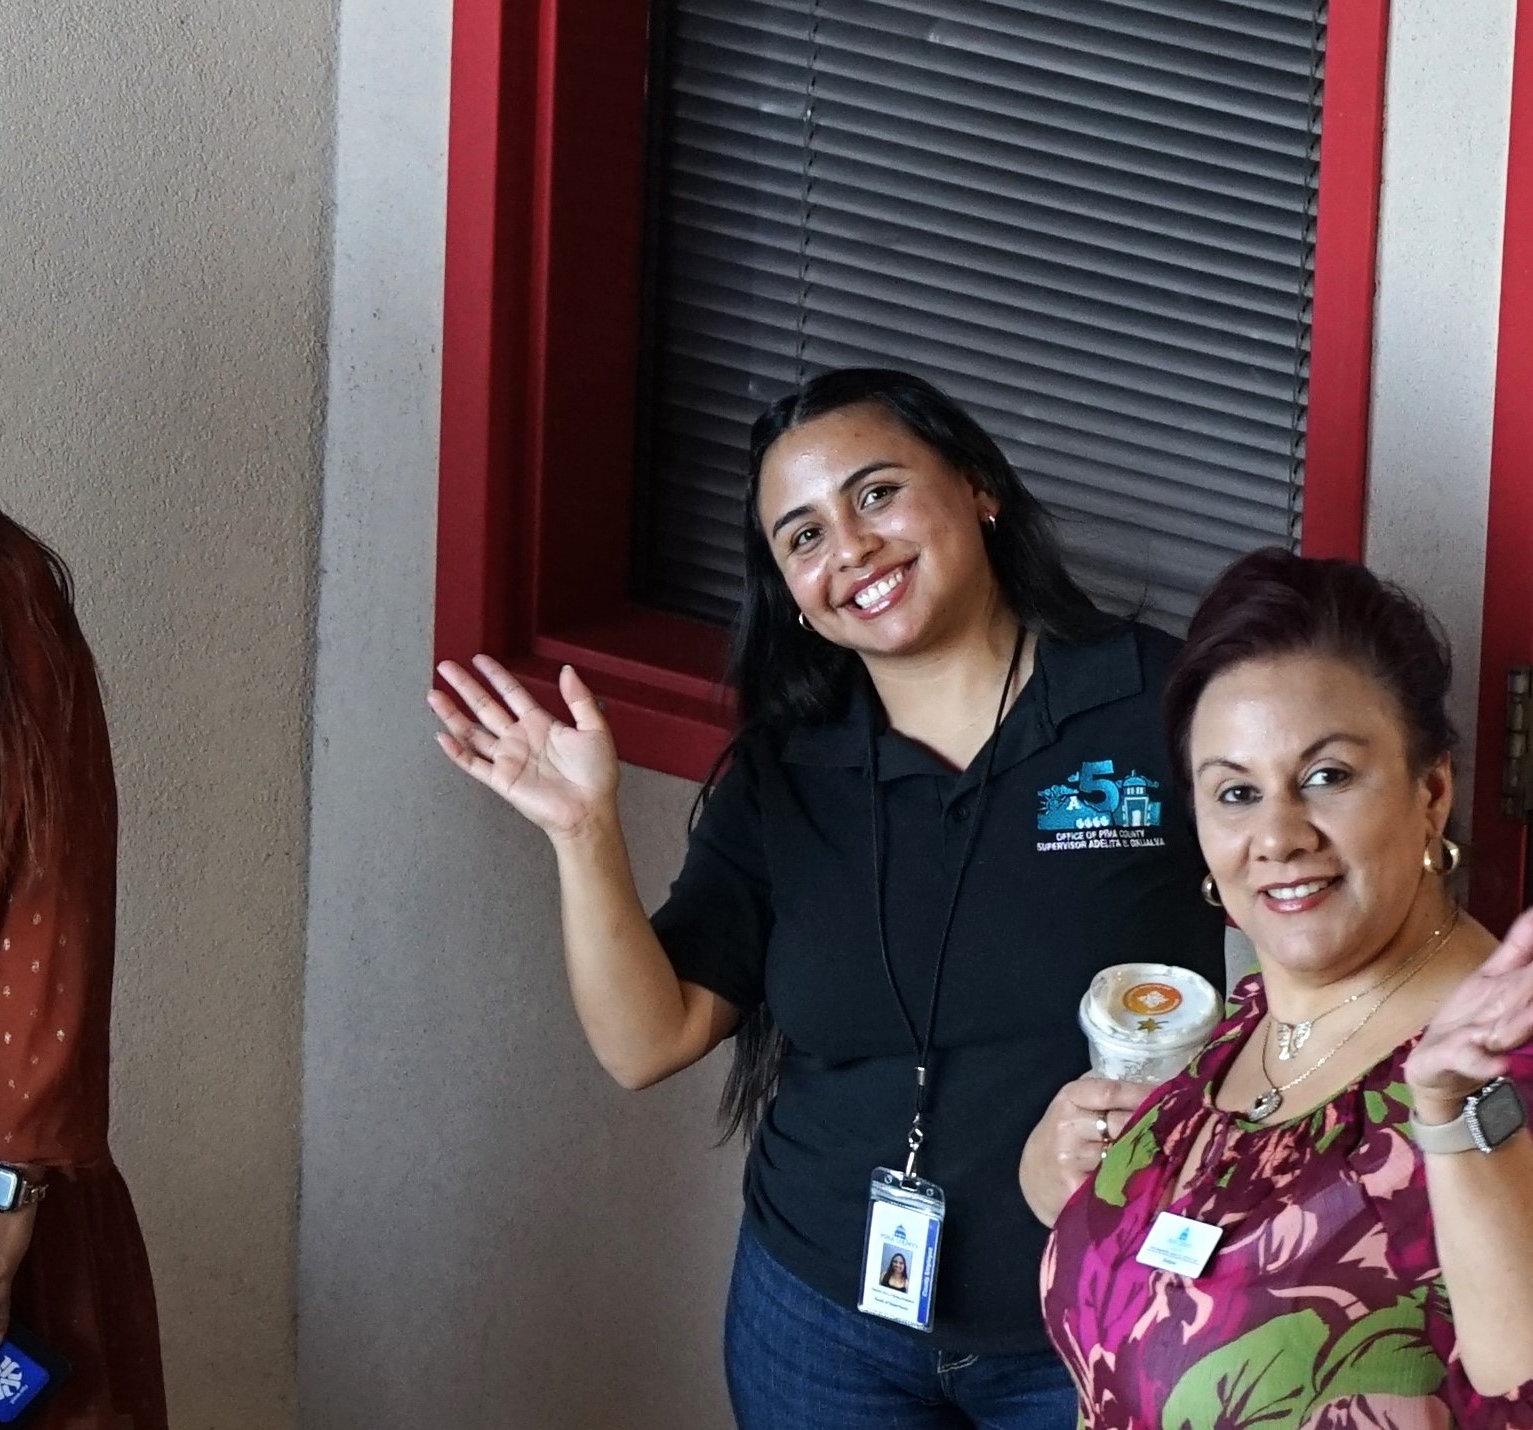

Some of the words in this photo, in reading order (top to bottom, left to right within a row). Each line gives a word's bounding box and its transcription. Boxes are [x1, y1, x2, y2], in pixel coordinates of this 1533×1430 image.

[1079, 759, 1121, 812] 5
[1066, 795, 1082, 811] A
[1055, 831, 1084, 842] OFFICE
[1085, 830, 1097, 839] OF
[1098, 828, 1117, 838] PIMA
[1118, 829, 1145, 838] COUNTY
[1036, 840, 1087, 853] SUPERVISOR
[1088, 838, 1122, 849] ADELITA
